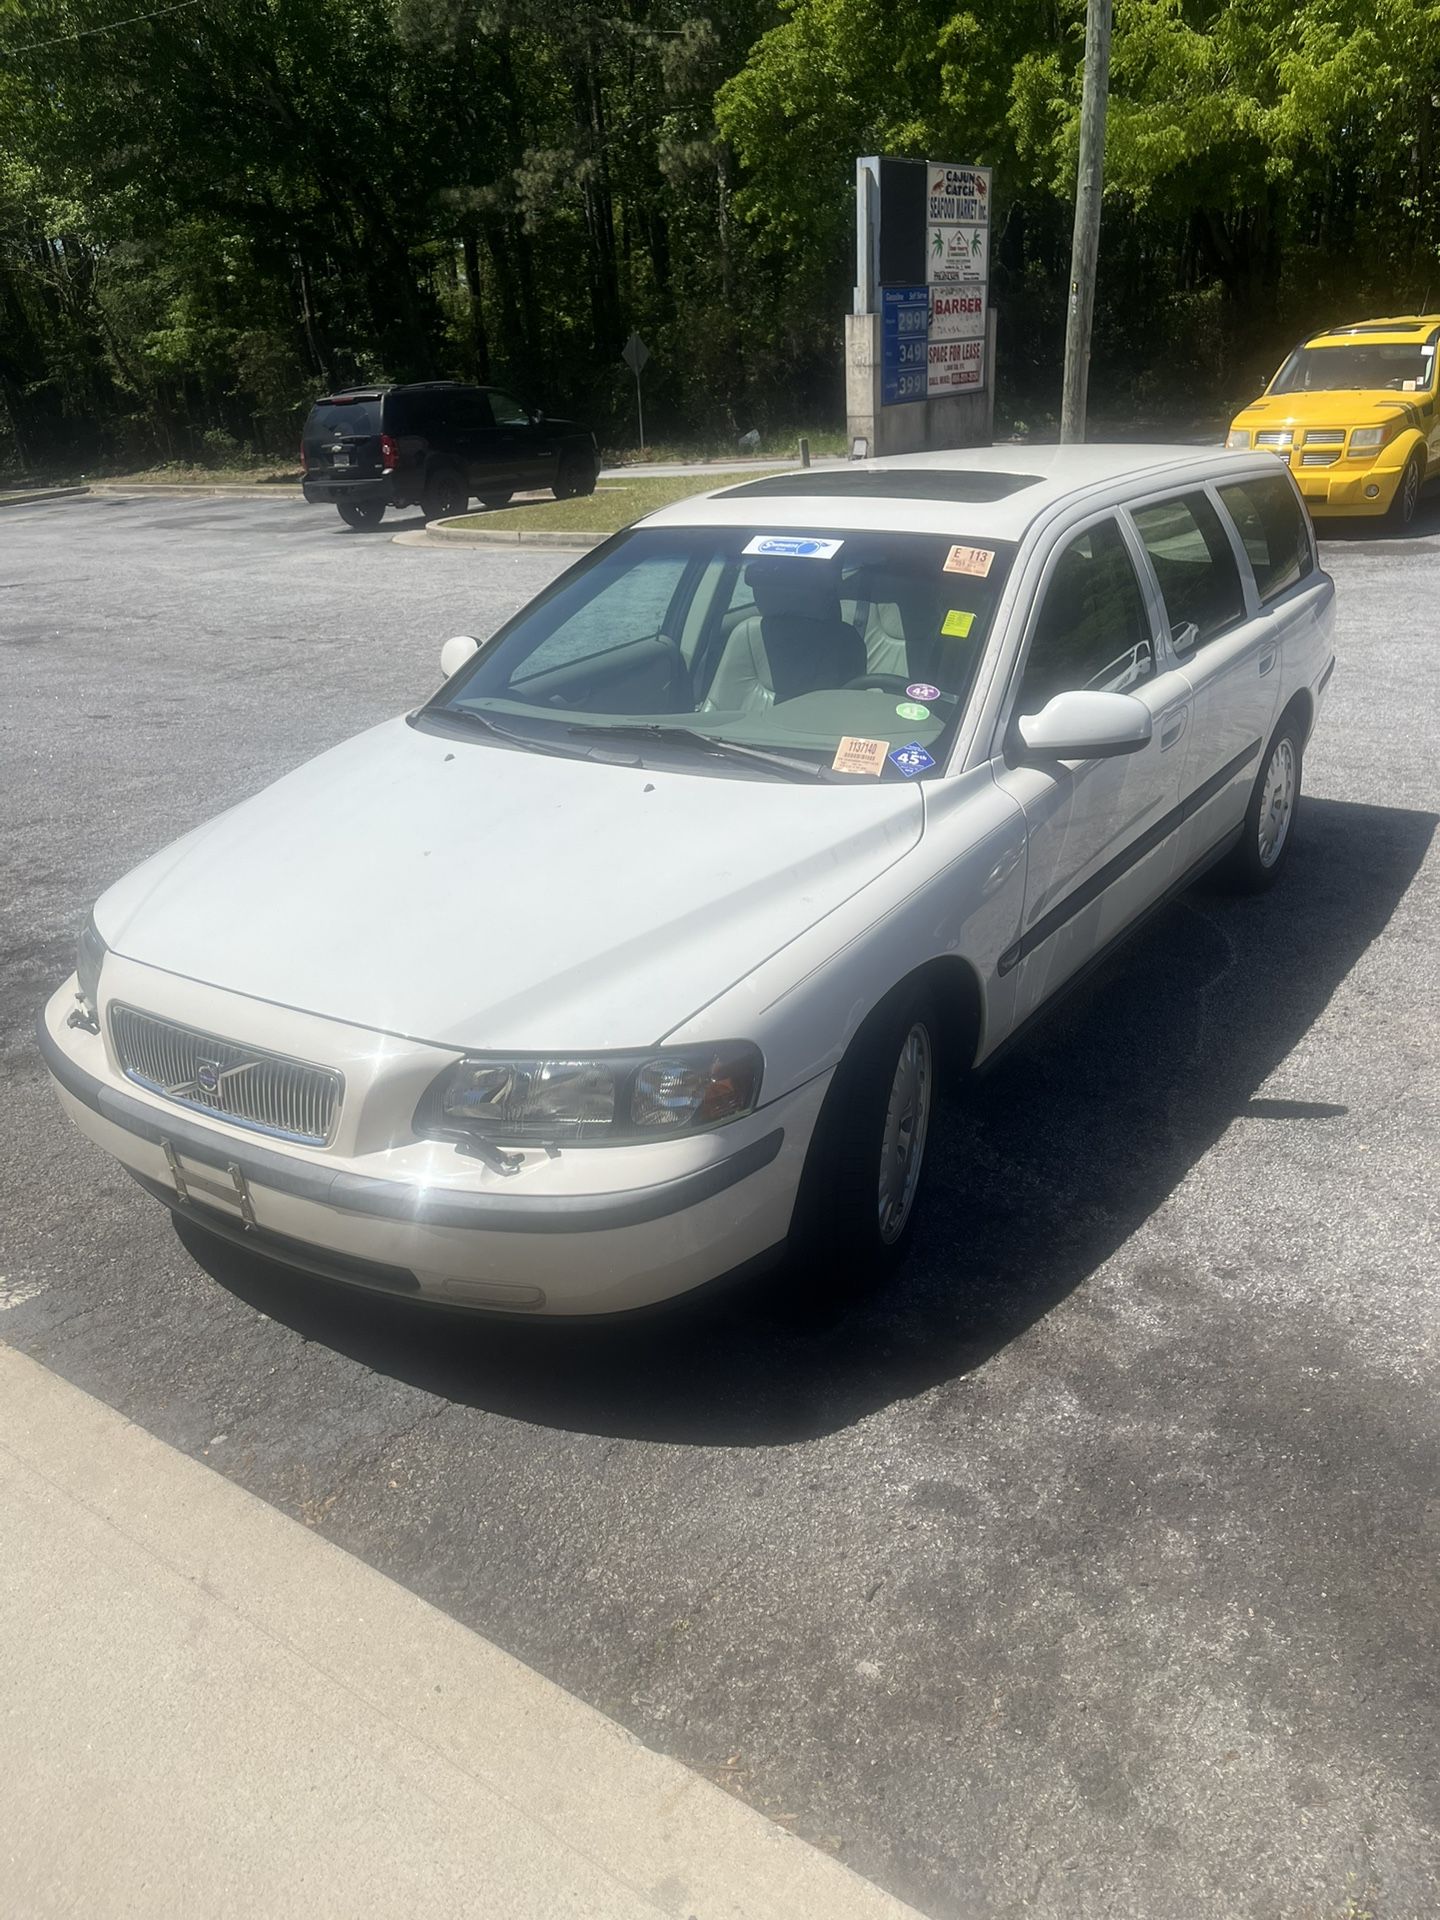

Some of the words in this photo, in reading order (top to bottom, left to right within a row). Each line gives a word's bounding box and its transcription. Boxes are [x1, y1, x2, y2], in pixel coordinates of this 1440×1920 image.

[946, 170, 975, 183] CAJUN
[945, 184, 974, 196] CATCH
[930, 196, 955, 219] SEAFOOD
[956, 198, 977, 220] MARKET
[935, 298, 982, 315] BARBER
[898, 311, 920, 331] 299
[899, 344, 921, 362] 349
[929, 346, 948, 364] SPACE
[949, 344, 960, 361] FOR
[962, 342, 980, 360] LEASE
[899, 376, 921, 394] 399
[953, 548, 962, 558] E
[969, 550, 988, 562] 113
[848, 741, 877, 755] 1137140
